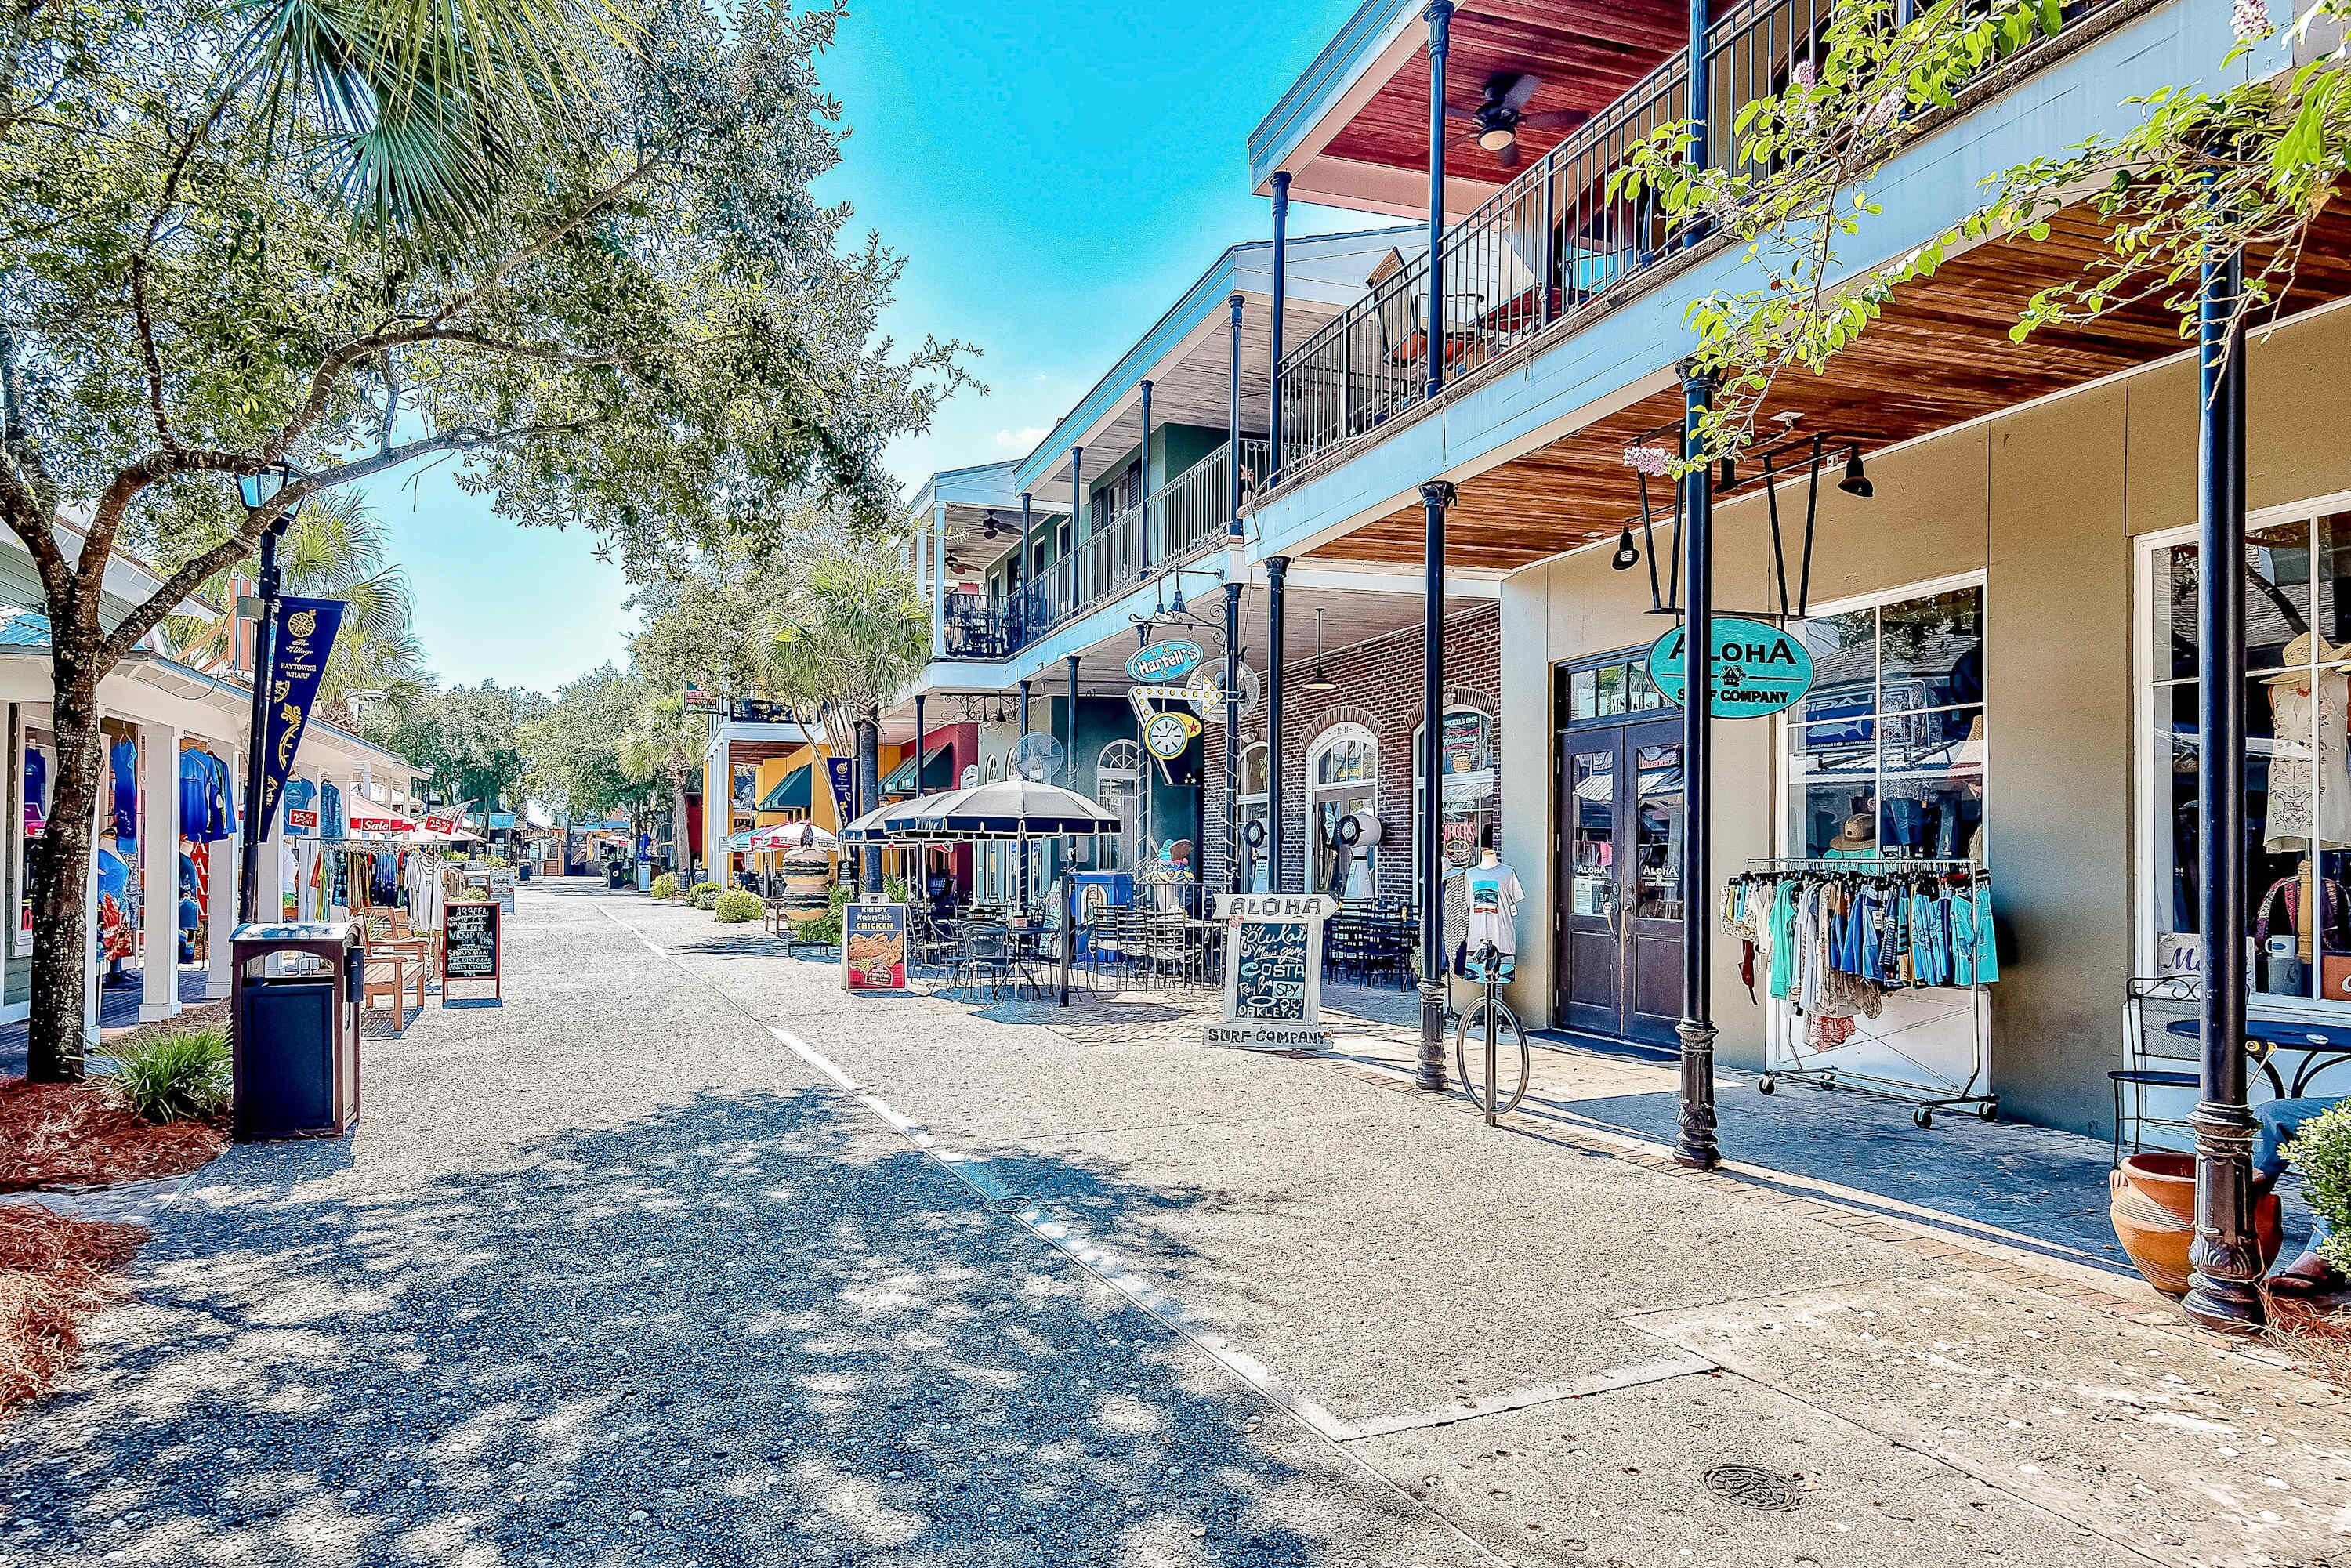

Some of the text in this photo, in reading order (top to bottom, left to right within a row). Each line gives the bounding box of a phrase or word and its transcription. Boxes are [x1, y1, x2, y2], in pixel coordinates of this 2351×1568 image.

[285, 646, 313, 656] Village
[1668, 633, 1797, 664] AOHA
[281, 663, 316, 672] BAYTOWNE
[1136, 648, 1197, 675] Hartell's
[1677, 689, 1789, 704] SF COMPANY
[293, 813, 314, 823] 25%
[363, 820, 389, 831] Sale
[1576, 864, 1607, 874] ALOHA
[1643, 865, 1678, 875] ALOHA
[1230, 897, 1321, 916] ALOHA
[1241, 961, 1305, 978] COSTA
[1277, 983, 1299, 996] SPY
[1237, 1005, 1289, 1019] OAKLEY
[1208, 1027, 1325, 1045] SURF COMPANY
